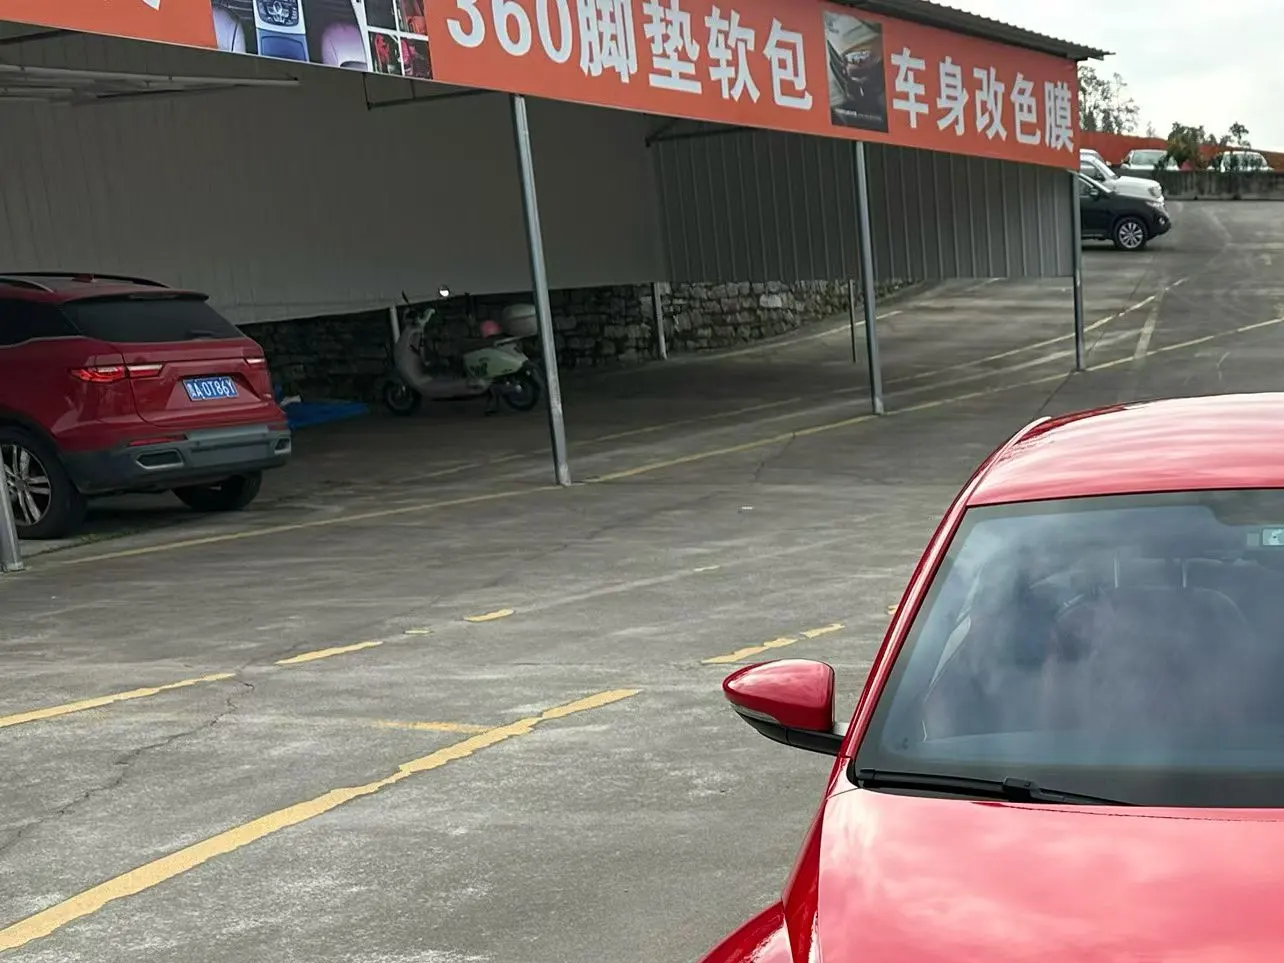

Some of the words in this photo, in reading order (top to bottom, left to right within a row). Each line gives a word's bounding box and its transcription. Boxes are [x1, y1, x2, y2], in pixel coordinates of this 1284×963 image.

[447, 0, 813, 110] 360脚垫软包
[891, 47, 1075, 153] 车身改色膜
